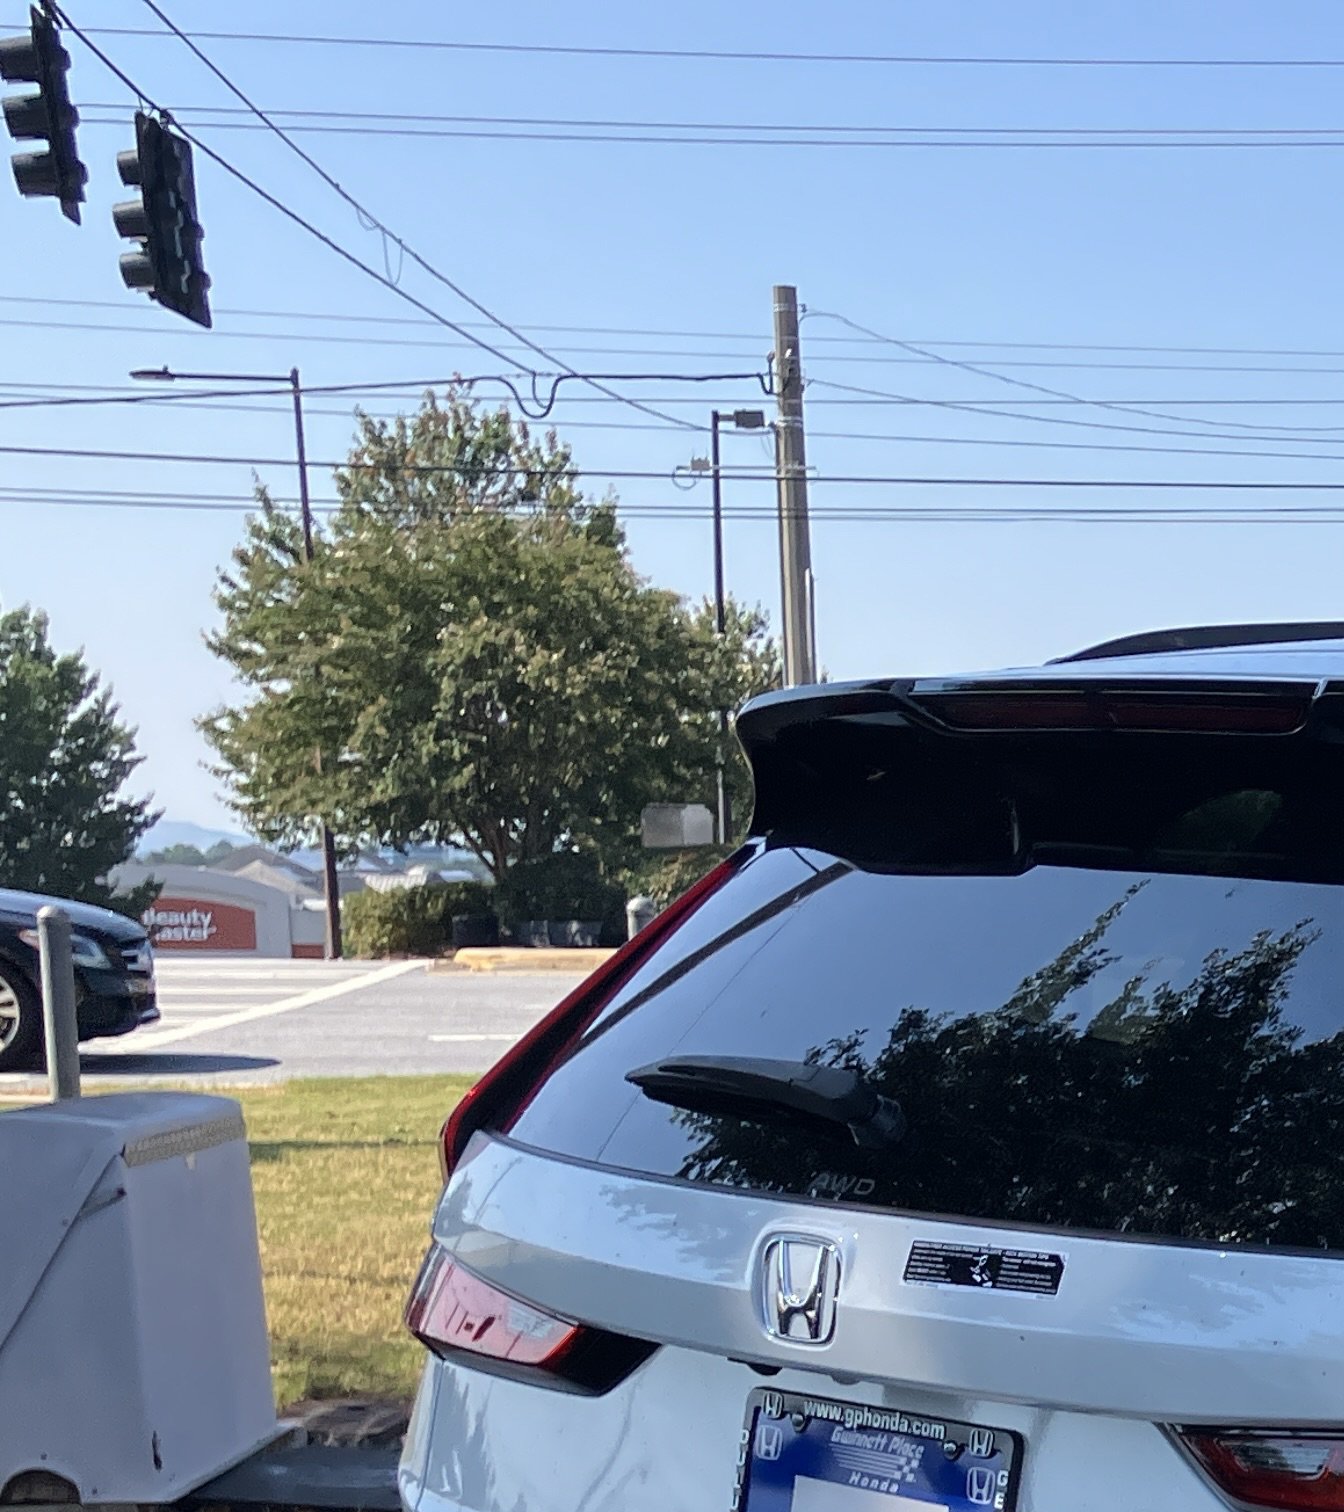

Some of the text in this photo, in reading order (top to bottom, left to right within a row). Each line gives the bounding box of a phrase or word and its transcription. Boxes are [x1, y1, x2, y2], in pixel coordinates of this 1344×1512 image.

[807, 1172, 876, 1197] AWD
[804, 1400, 945, 1439] www.gphonda.com
[831, 1427, 925, 1460] Gwinnett Place
[848, 1471, 899, 1493] Honda
